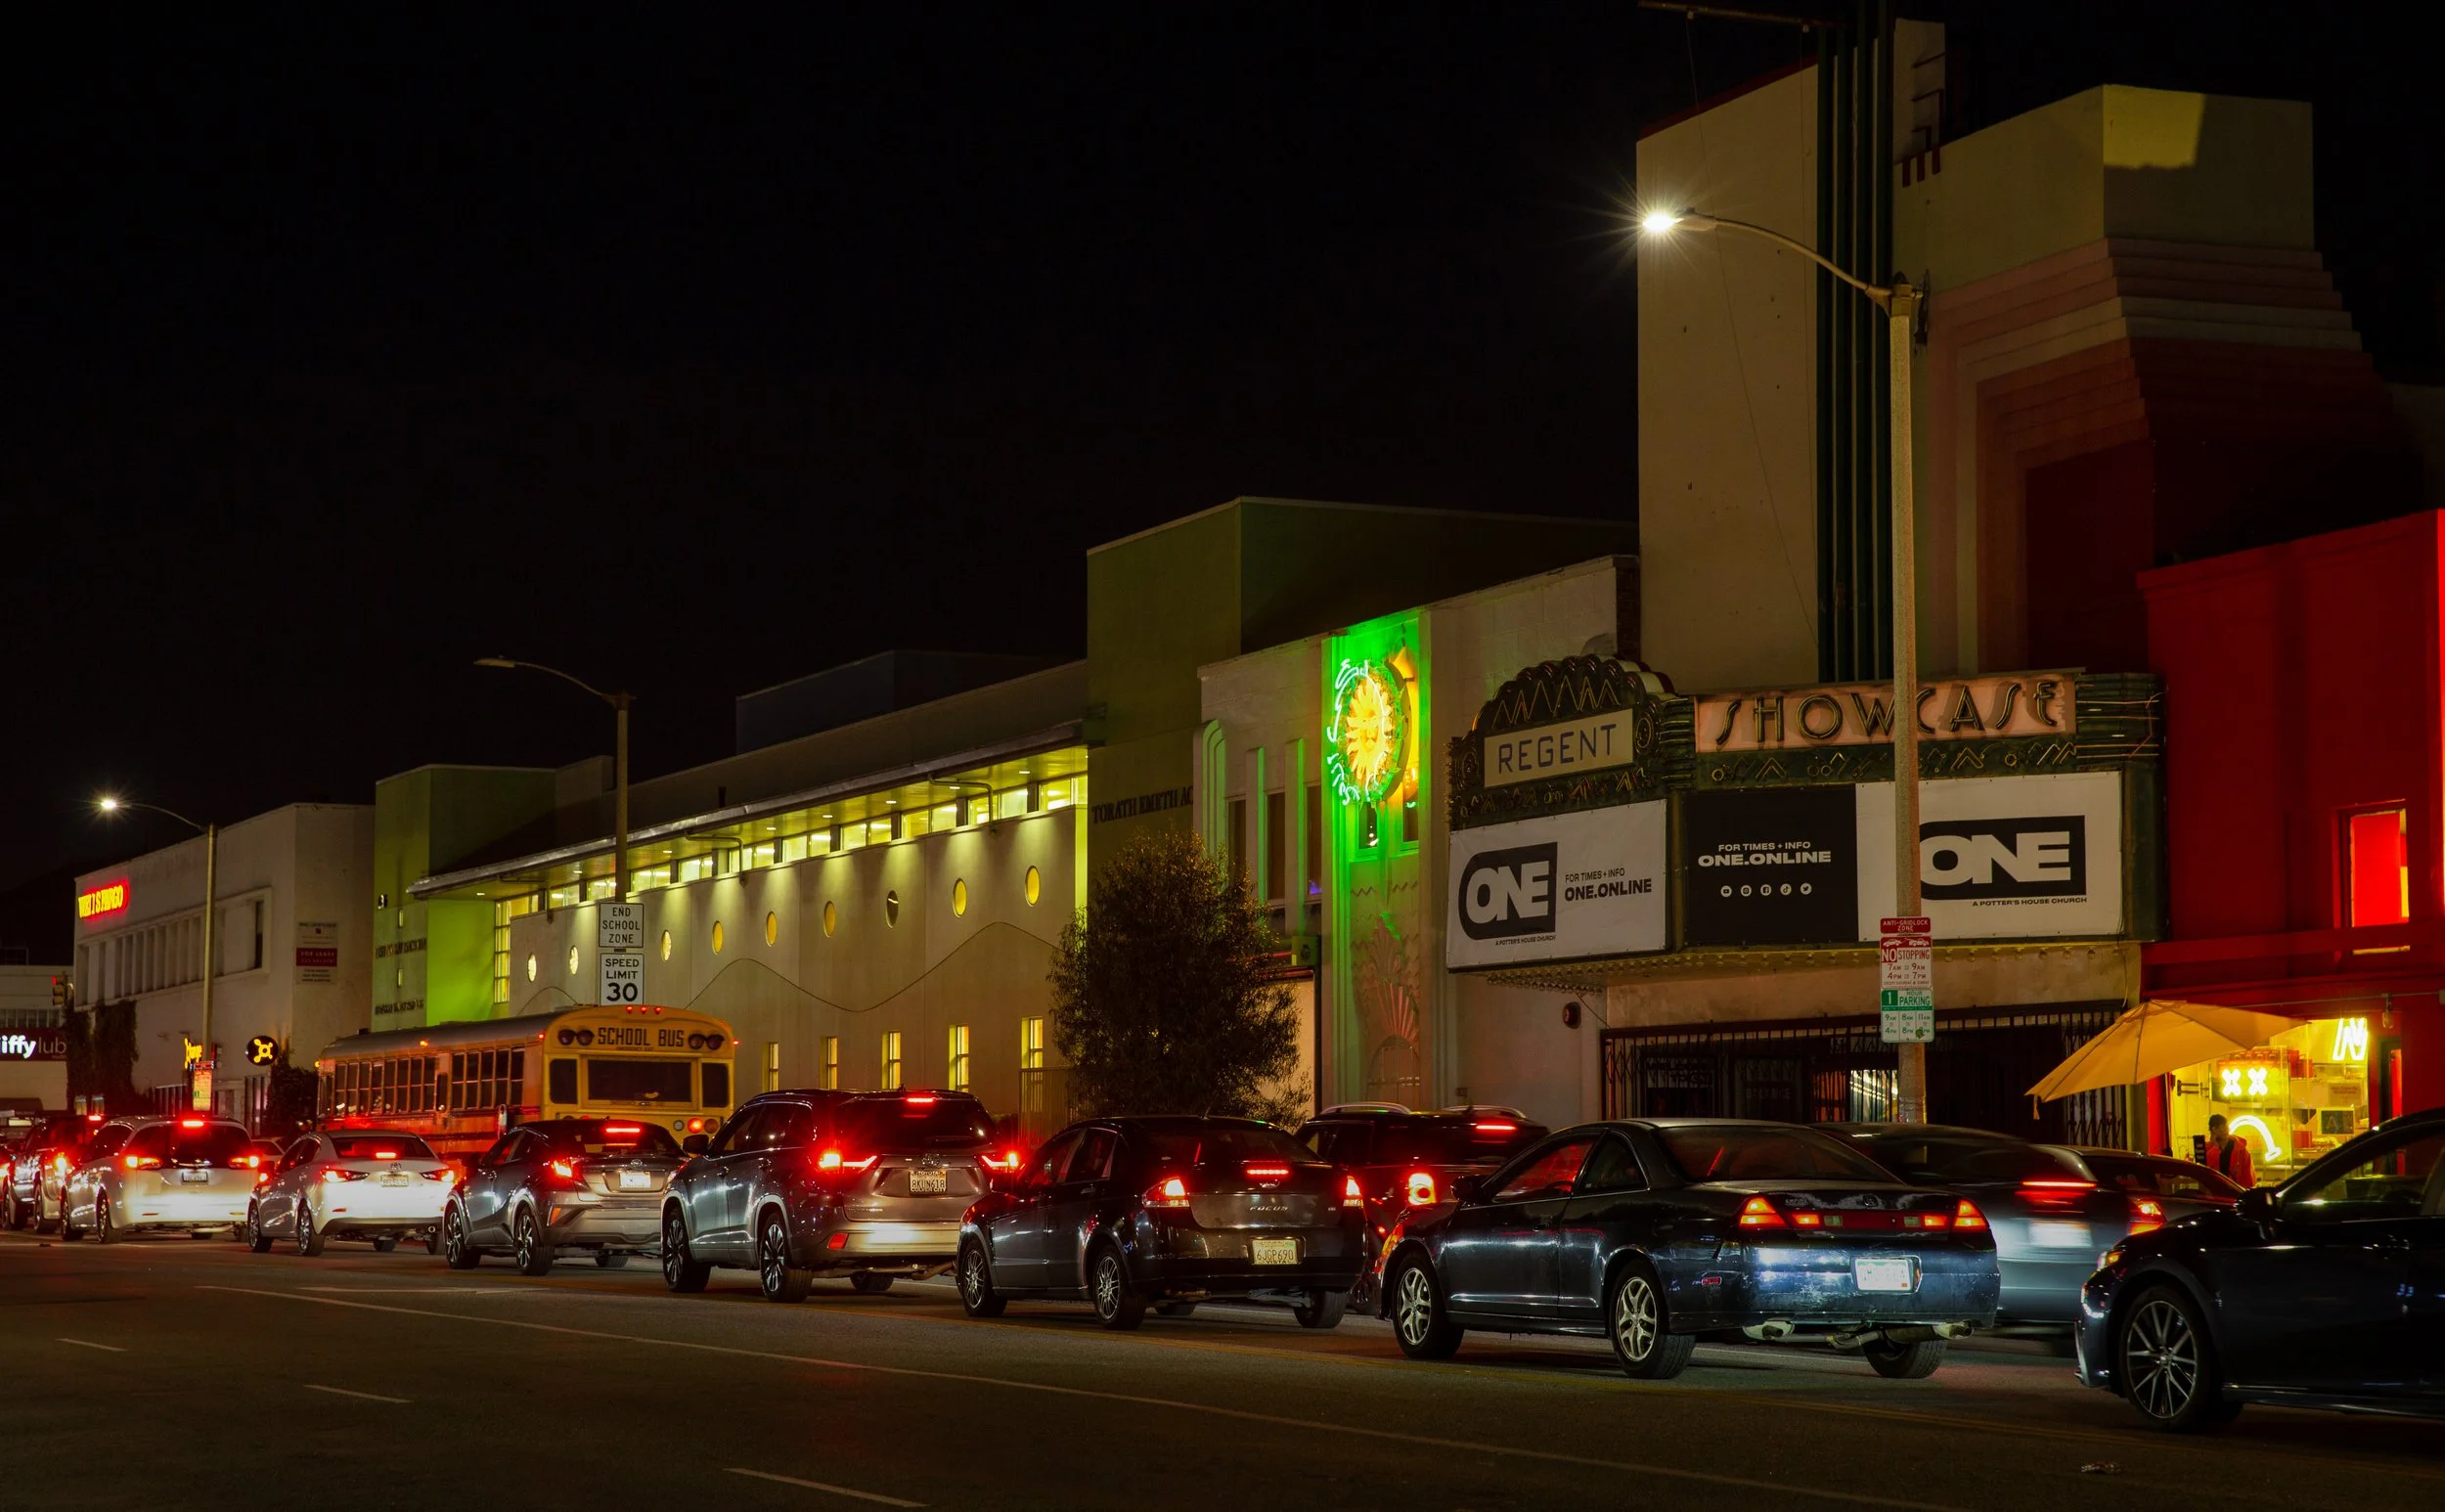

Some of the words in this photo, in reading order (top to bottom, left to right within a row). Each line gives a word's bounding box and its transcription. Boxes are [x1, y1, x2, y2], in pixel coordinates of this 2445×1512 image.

[1716, 681, 2059, 745] SHOWCASE
[1498, 724, 1617, 774] REGENT
[1091, 797, 1136, 823] TORATH
[1139, 788, 1178, 814] EMETH
[1743, 842, 1775, 851] TIMES
[1785, 841, 1811, 850] INFO
[1698, 851, 1832, 867] ONE.ONLINE
[1919, 831, 2071, 886] ONE
[1565, 873, 1579, 883] FOR
[1580, 870, 1602, 881] TIMES
[1608, 867, 1625, 878] INFO
[1466, 860, 1550, 924] ONE
[1565, 878, 1652, 902] ONE.ONLINE
[612, 907, 631, 916] END
[602, 920, 641, 930] SCHOOL
[608, 934, 634, 944] ZONE
[1521, 936, 1536, 945] HOUSE
[605, 958, 640, 967] SPEED
[1882, 949, 1897, 962] NO
[1897, 950, 1931, 959] STOPPING
[1912, 962, 1926, 971] 9AM
[606, 970, 639, 979] LIMIT
[606, 982, 639, 1002] 30
[1888, 992, 1891, 1004] 1
[1899, 997, 1931, 1006] PARKING
[599, 1027, 651, 1046] SCHOOL
[658, 1029, 685, 1047] BUS
[0, 1035, 37, 1059] iffy
